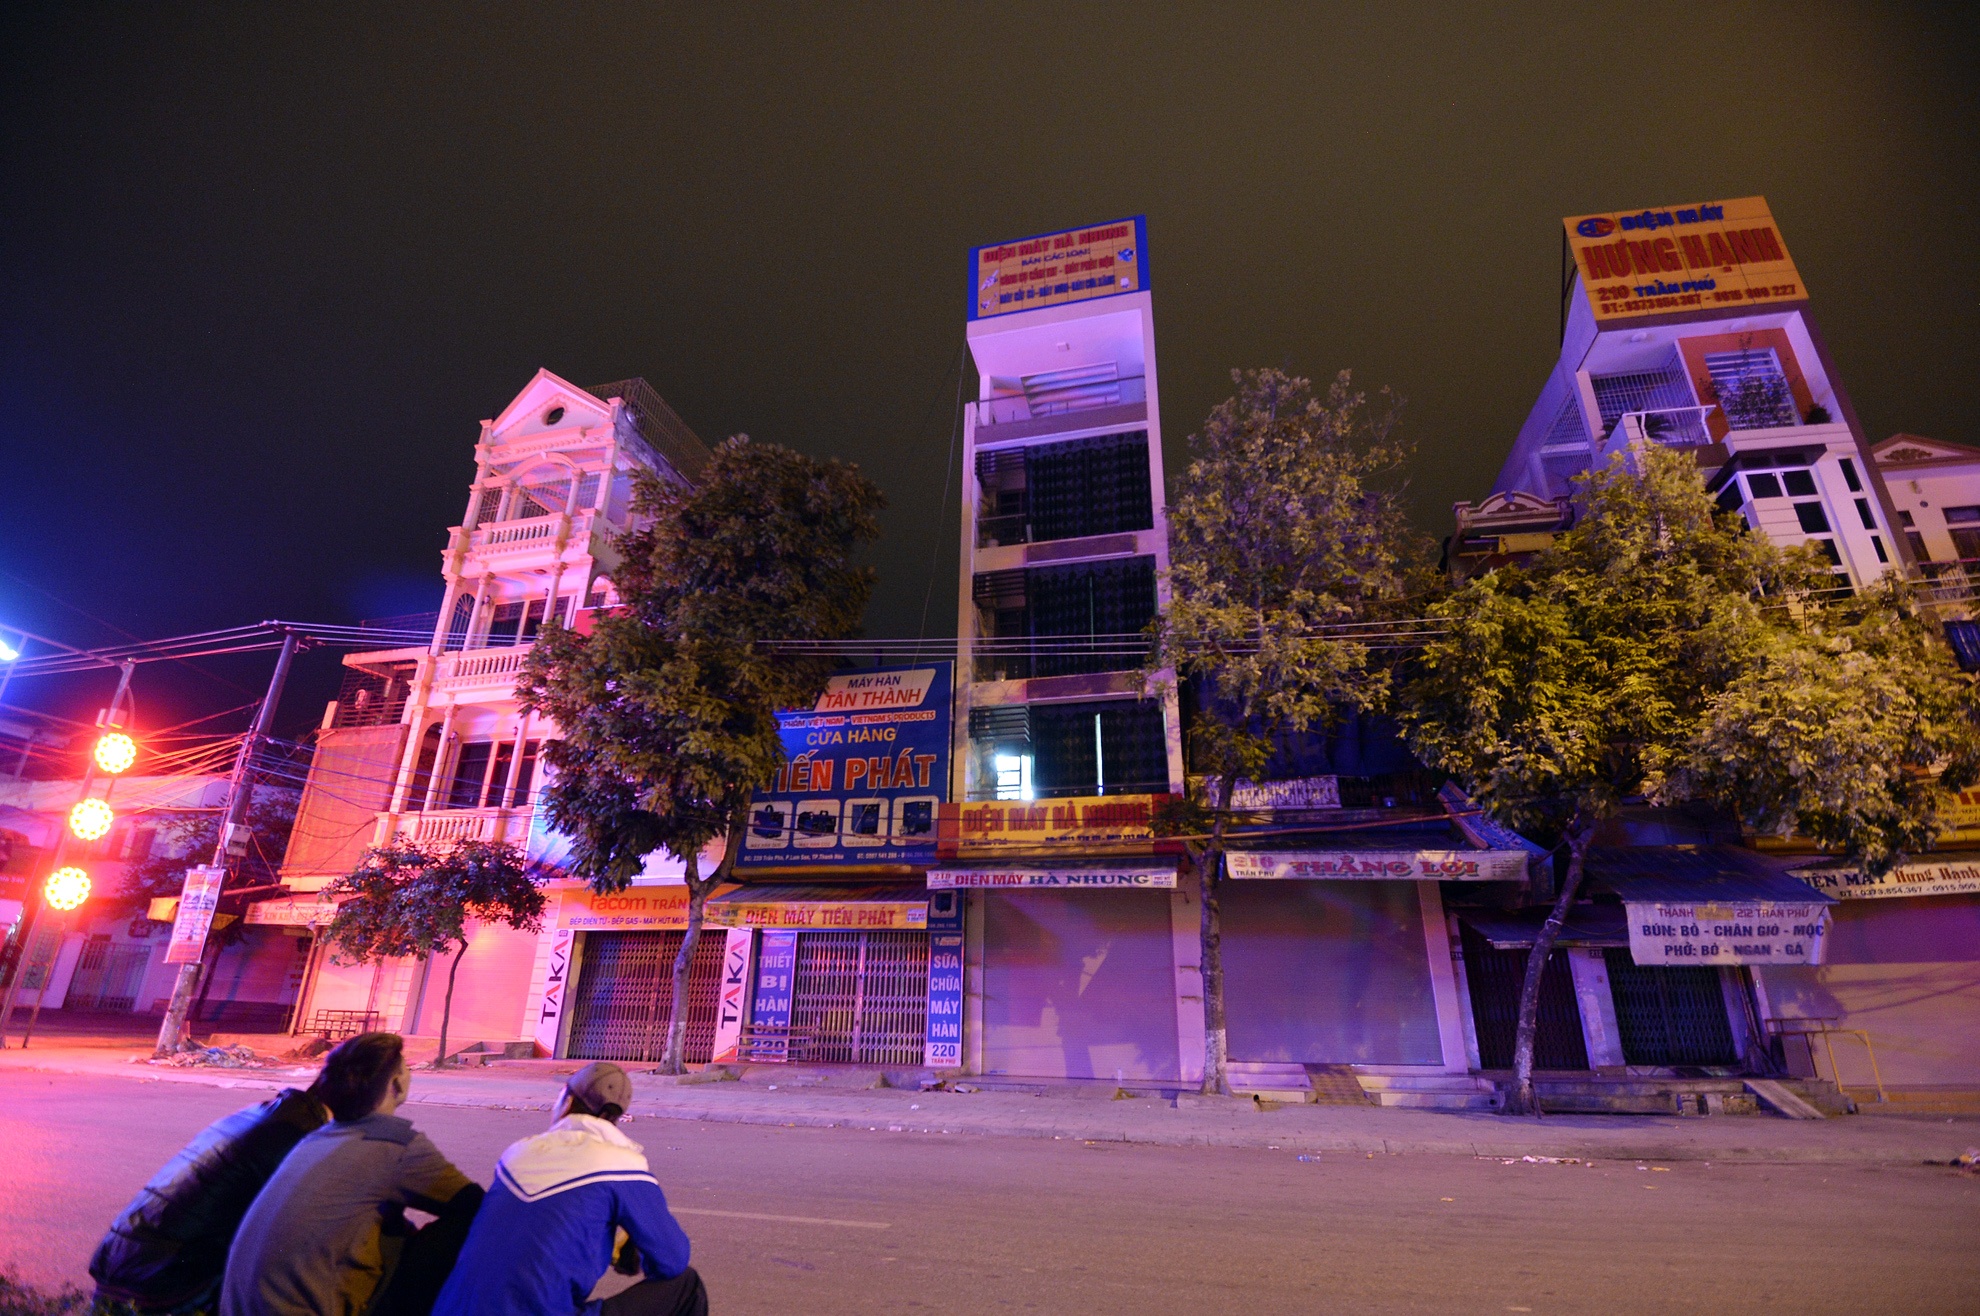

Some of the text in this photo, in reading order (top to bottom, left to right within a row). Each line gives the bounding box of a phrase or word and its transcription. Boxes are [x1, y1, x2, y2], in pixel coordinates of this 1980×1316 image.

[1620, 205, 1724, 230] ĐIỆN MÁY
[984, 226, 1128, 263] ĐIỆN MÁY HÀ NHUNG
[1582, 227, 1785, 280] HƯNG HẠNH
[1597, 274, 1716, 301] 210 TRẦN PHÚ
[1772, 284, 1796, 296] 227
[848, 673, 901, 689] MÁY HÀN
[826, 686, 922, 708] TÂN THÀNH
[809, 716, 824, 728] VIỆT
[826, 717, 844, 725] NAM
[894, 712, 935, 722] PRODUCTS
[807, 726, 896, 746] CỬA HÀNG
[844, 748, 936, 790] PHÁT
[963, 800, 1148, 838] ĐIỆN MÁY HÀ NHUNG
[1420, 859, 1479, 880] LỢI
[956, 873, 989, 885] ĐIỆN
[992, 872, 1024, 884] MÁY
[1029, 872, 1060, 884] HÀ
[1066, 874, 1150, 884] NHUNG
[590, 894, 647, 911] facom
[611, 914, 624, 924] BẾP
[643, 916, 656, 924] MÁY
[658, 915, 671, 924] HÚT
[746, 908, 778, 927] ĐIỆN
[784, 904, 815, 925] MÁY
[822, 906, 852, 924] TIẾN
[857, 907, 896, 925] PHÁT
[1643, 924, 1676, 936] BÚN:
[1681, 924, 1699, 936] BÒ
[1714, 924, 1752, 936] CHÂN
[1757, 924, 1779, 936] GIÒ
[1794, 924, 1824, 937] MỘC
[1665, 942, 1696, 956] PHỞ:
[1701, 943, 1719, 955] BÒ
[1734, 944, 1770, 956] NGAN
[1785, 943, 1803, 955] GÀ
[758, 951, 792, 968] THIẾT
[541, 939, 568, 1024] TAKA
[721, 938, 746, 1029] TAKA
[761, 976, 787, 991] BỊ
[931, 974, 960, 991] CHỮA
[755, 996, 788, 1012] HÀN
[931, 997, 959, 1014] MÁY
[932, 1020, 958, 1038] HÀN
[932, 1045, 955, 1057] 220
